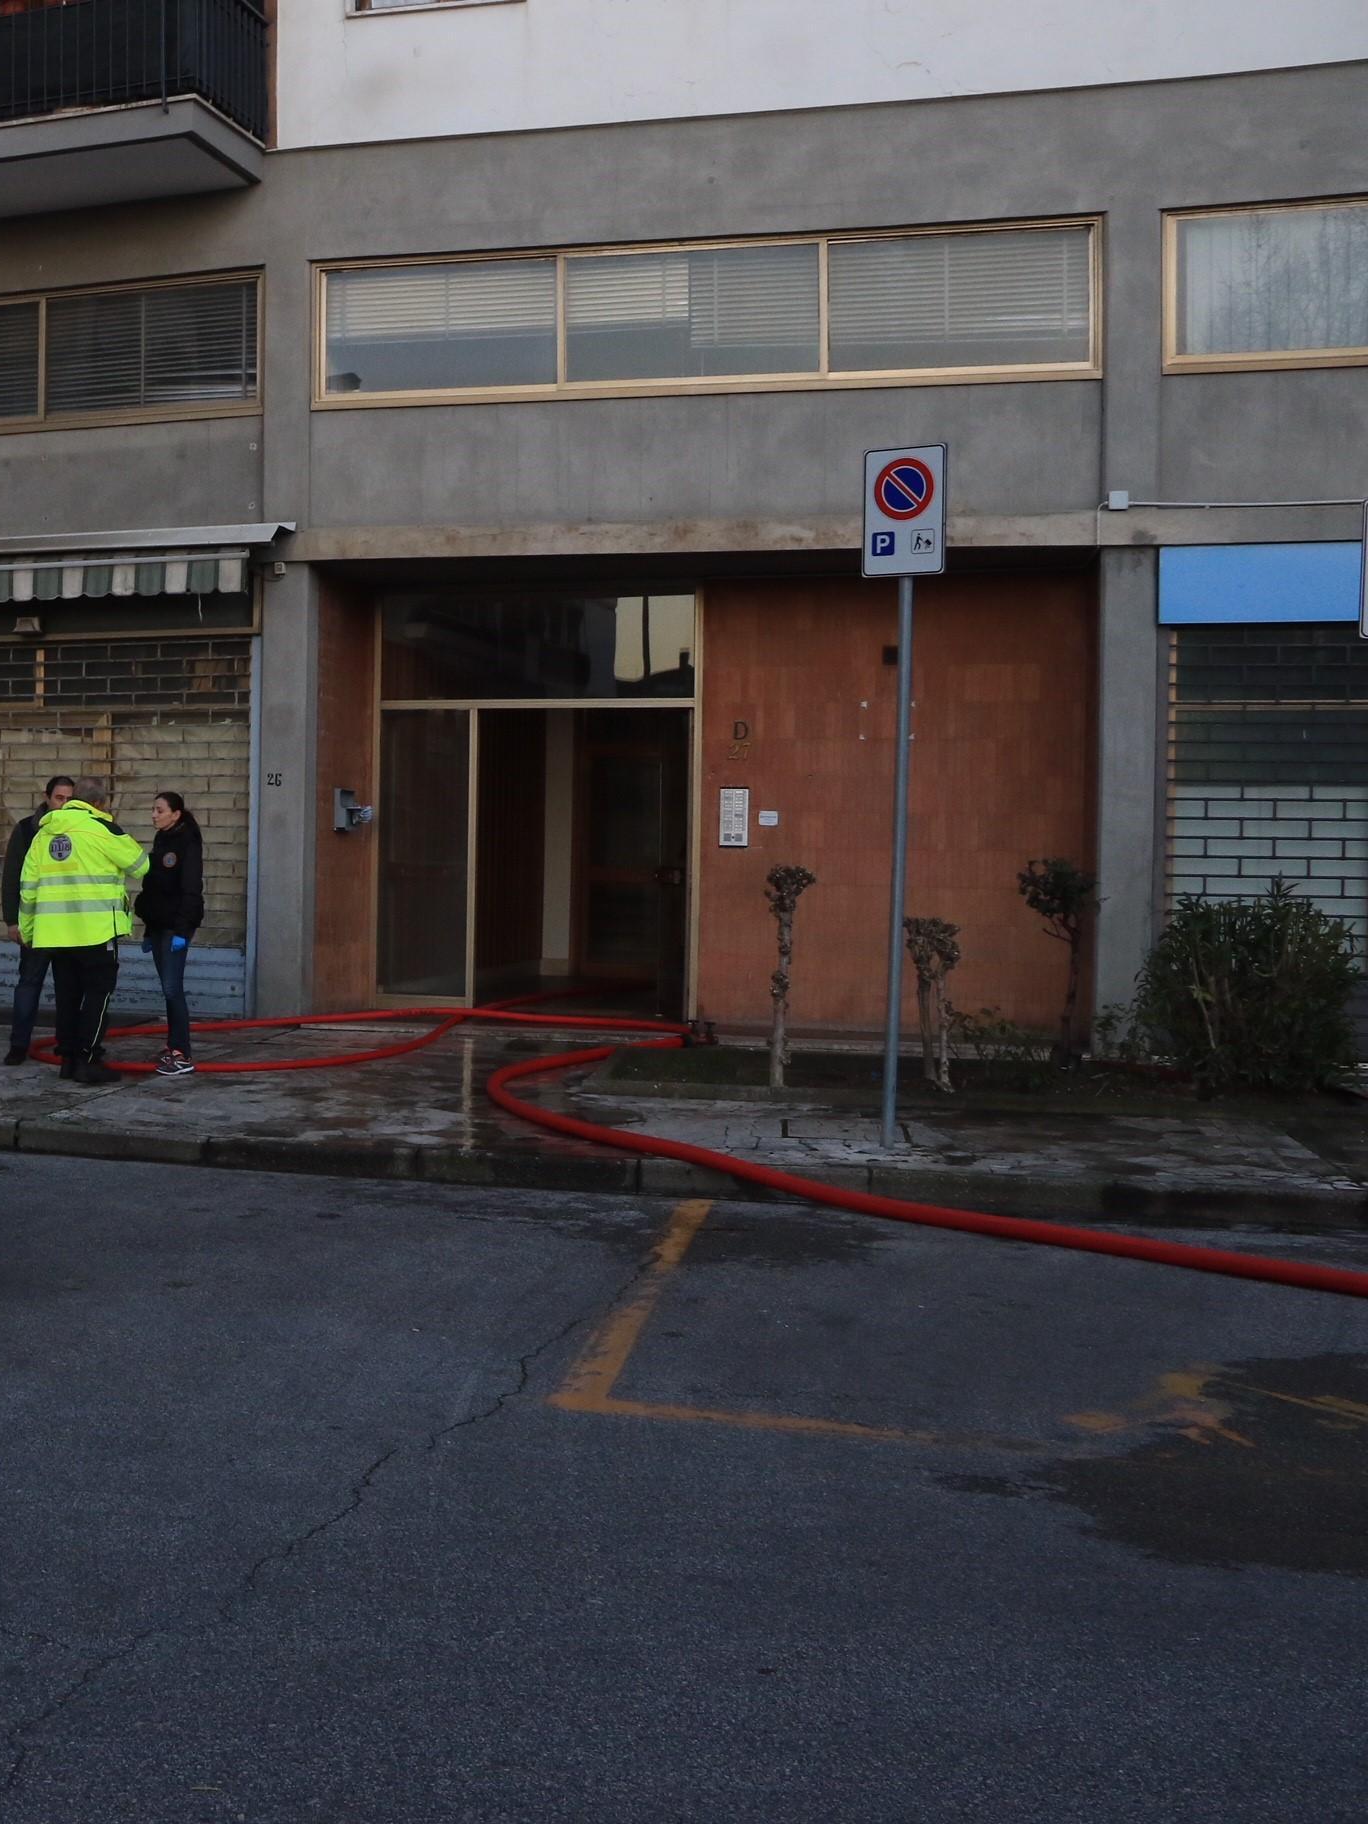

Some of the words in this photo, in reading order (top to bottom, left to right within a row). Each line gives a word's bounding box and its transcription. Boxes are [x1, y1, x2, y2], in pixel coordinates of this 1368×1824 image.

[876, 535, 890, 554] P
[734, 721, 749, 740] D
[267, 773, 282, 786] 26
